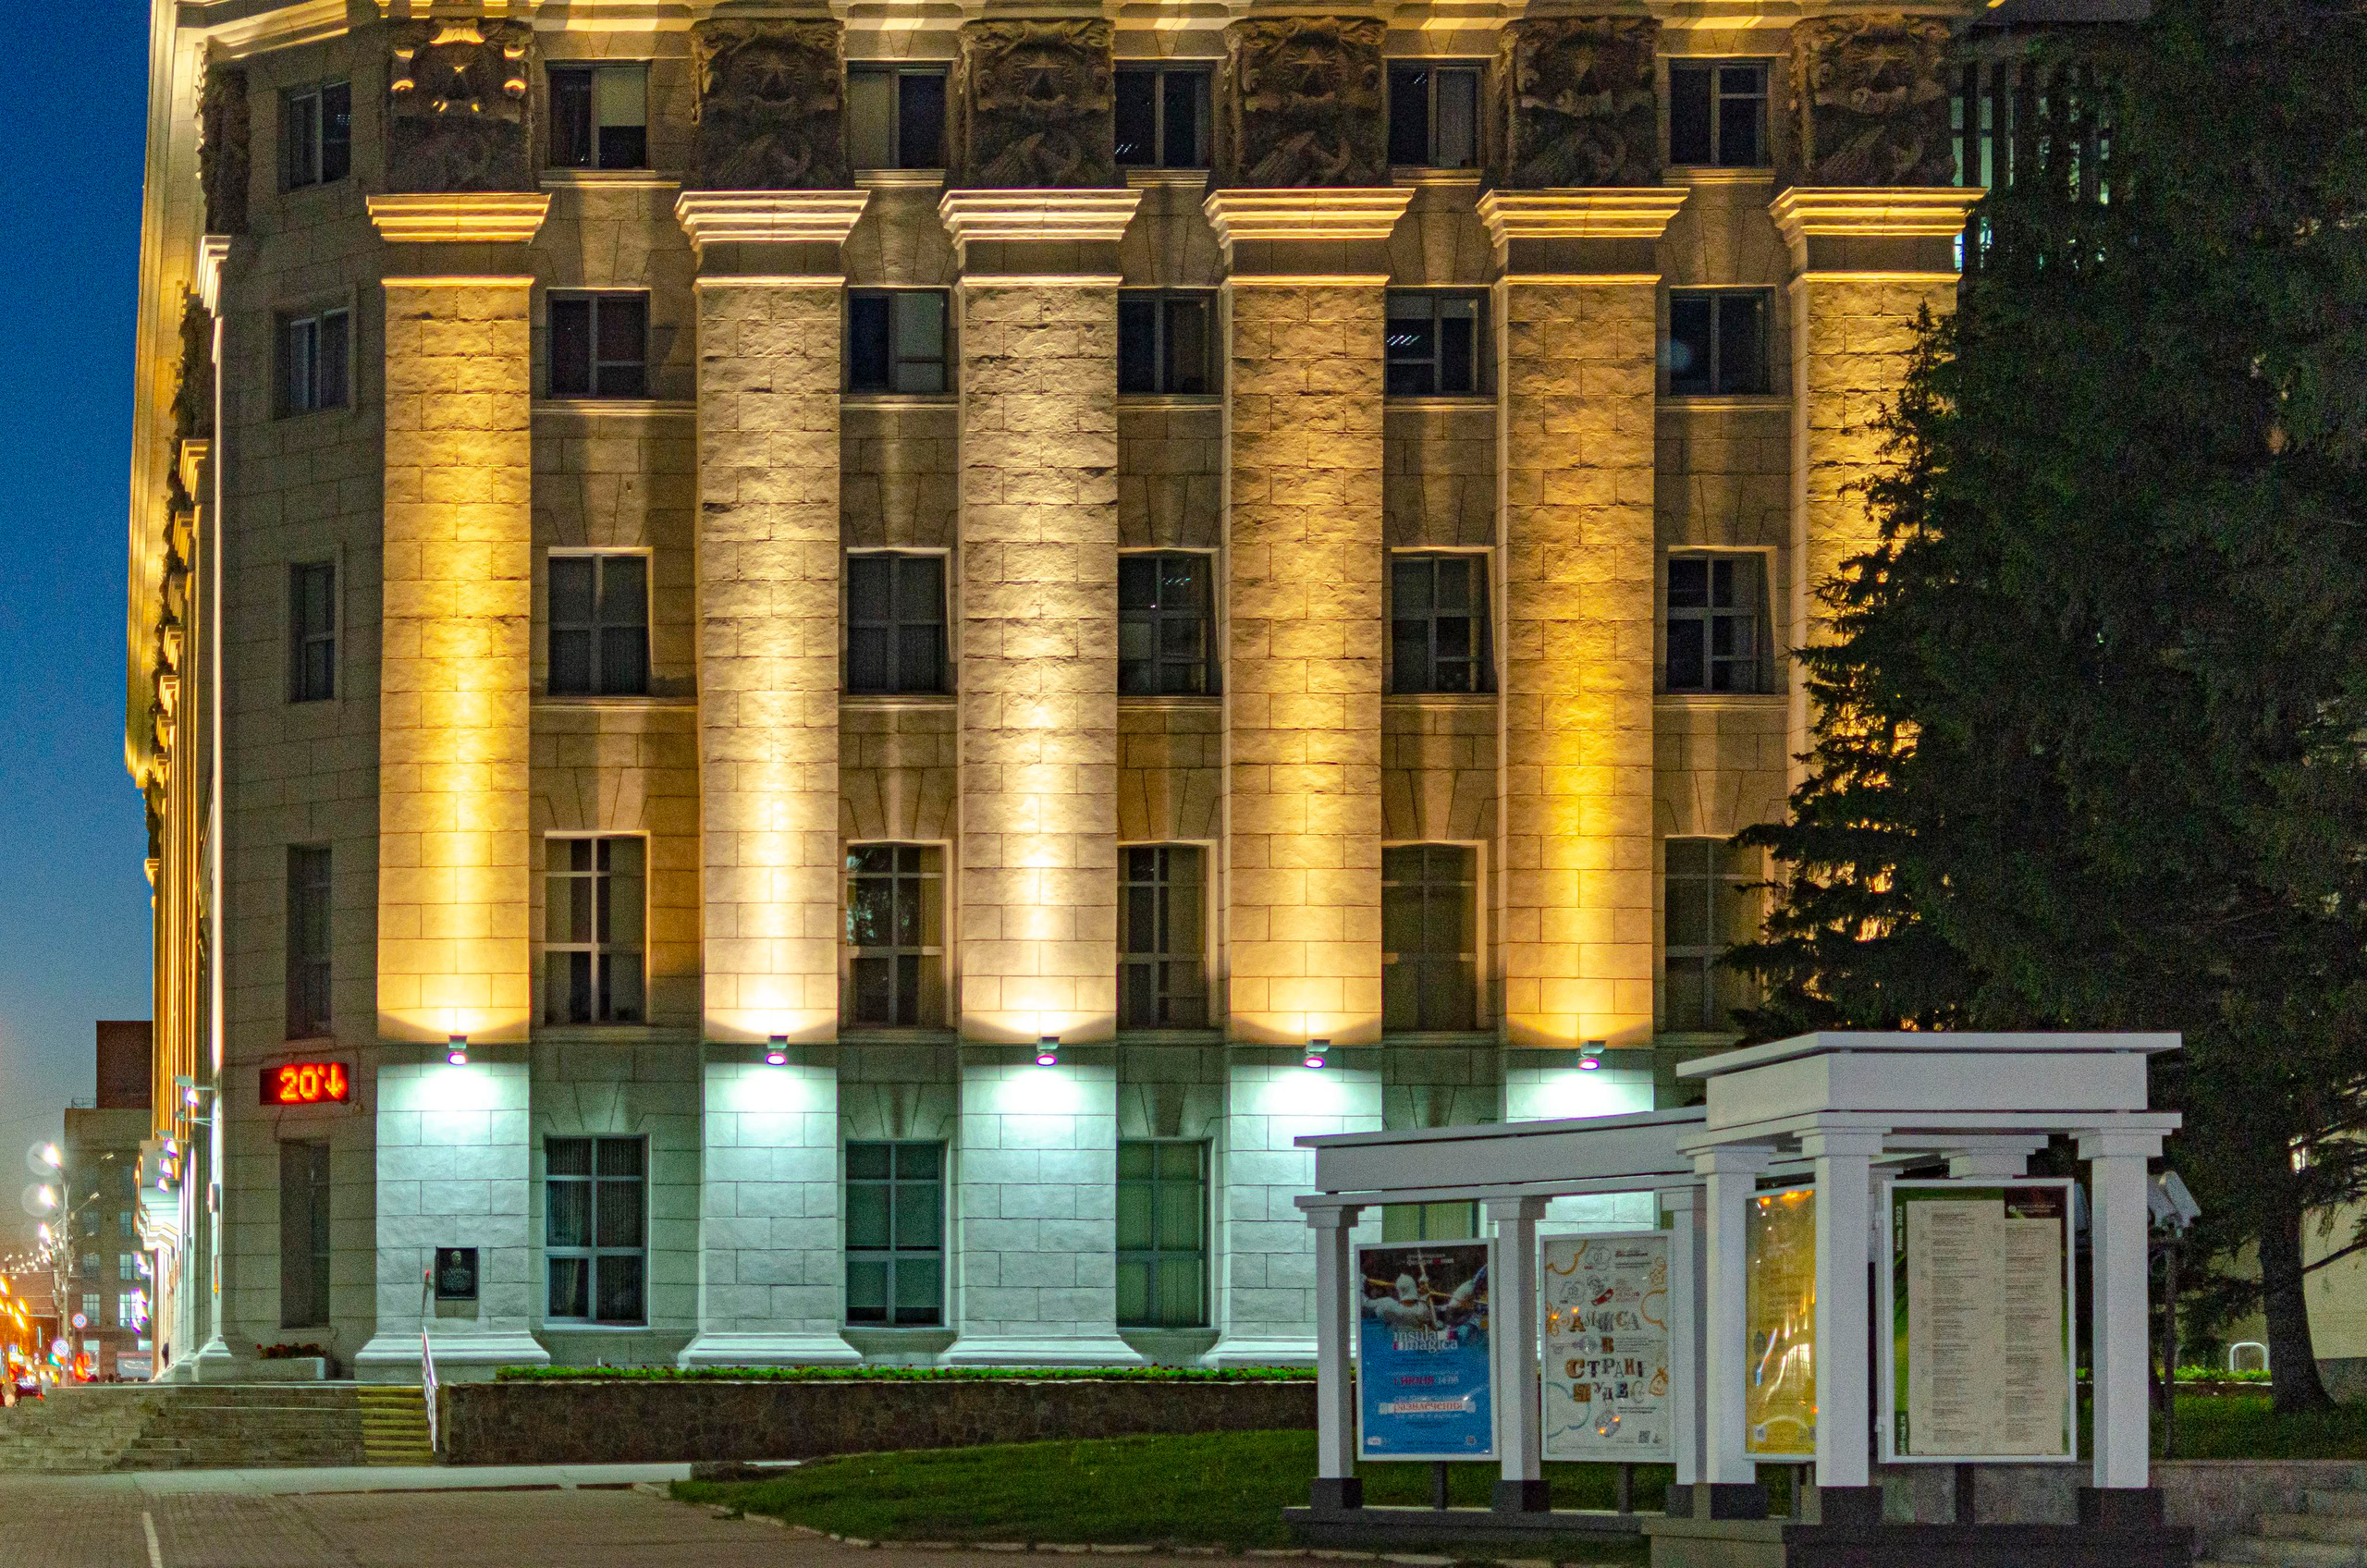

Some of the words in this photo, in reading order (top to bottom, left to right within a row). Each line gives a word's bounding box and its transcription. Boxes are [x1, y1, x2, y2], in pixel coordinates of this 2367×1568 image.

[1570, 1311, 1642, 1332] АЛИСА
[1392, 1324, 1438, 1341] insula
[1404, 1339, 1458, 1354] magica
[1565, 1357, 1647, 1378] СТРАНЕ
[1574, 1381, 1646, 1403] ЧУДЕС
